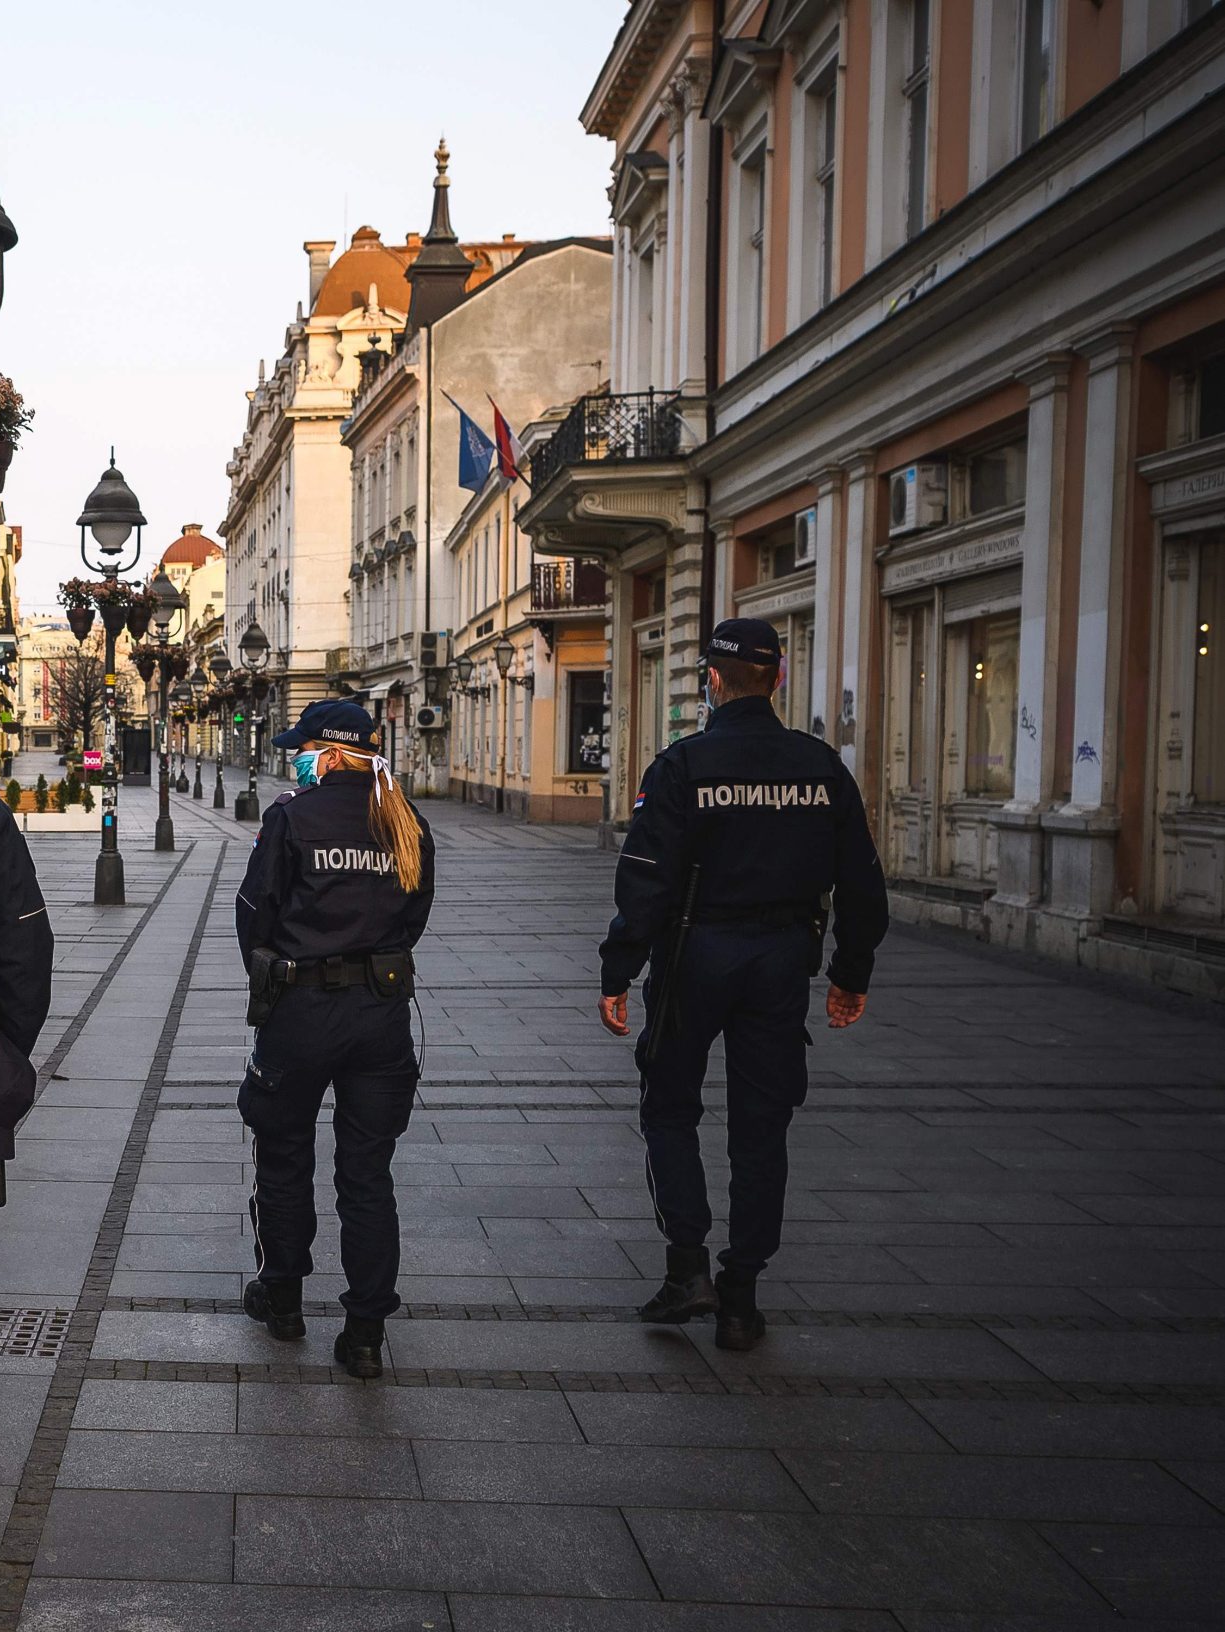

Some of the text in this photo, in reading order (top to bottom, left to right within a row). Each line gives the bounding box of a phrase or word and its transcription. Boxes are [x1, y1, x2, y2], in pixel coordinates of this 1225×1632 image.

[322, 728, 360, 742] ПОЛИЦИЈА
[84, 756, 101, 765] box
[697, 784, 830, 810] ПОЛИЦИЈА
[314, 848, 398, 876] ПОЛИЦИ
